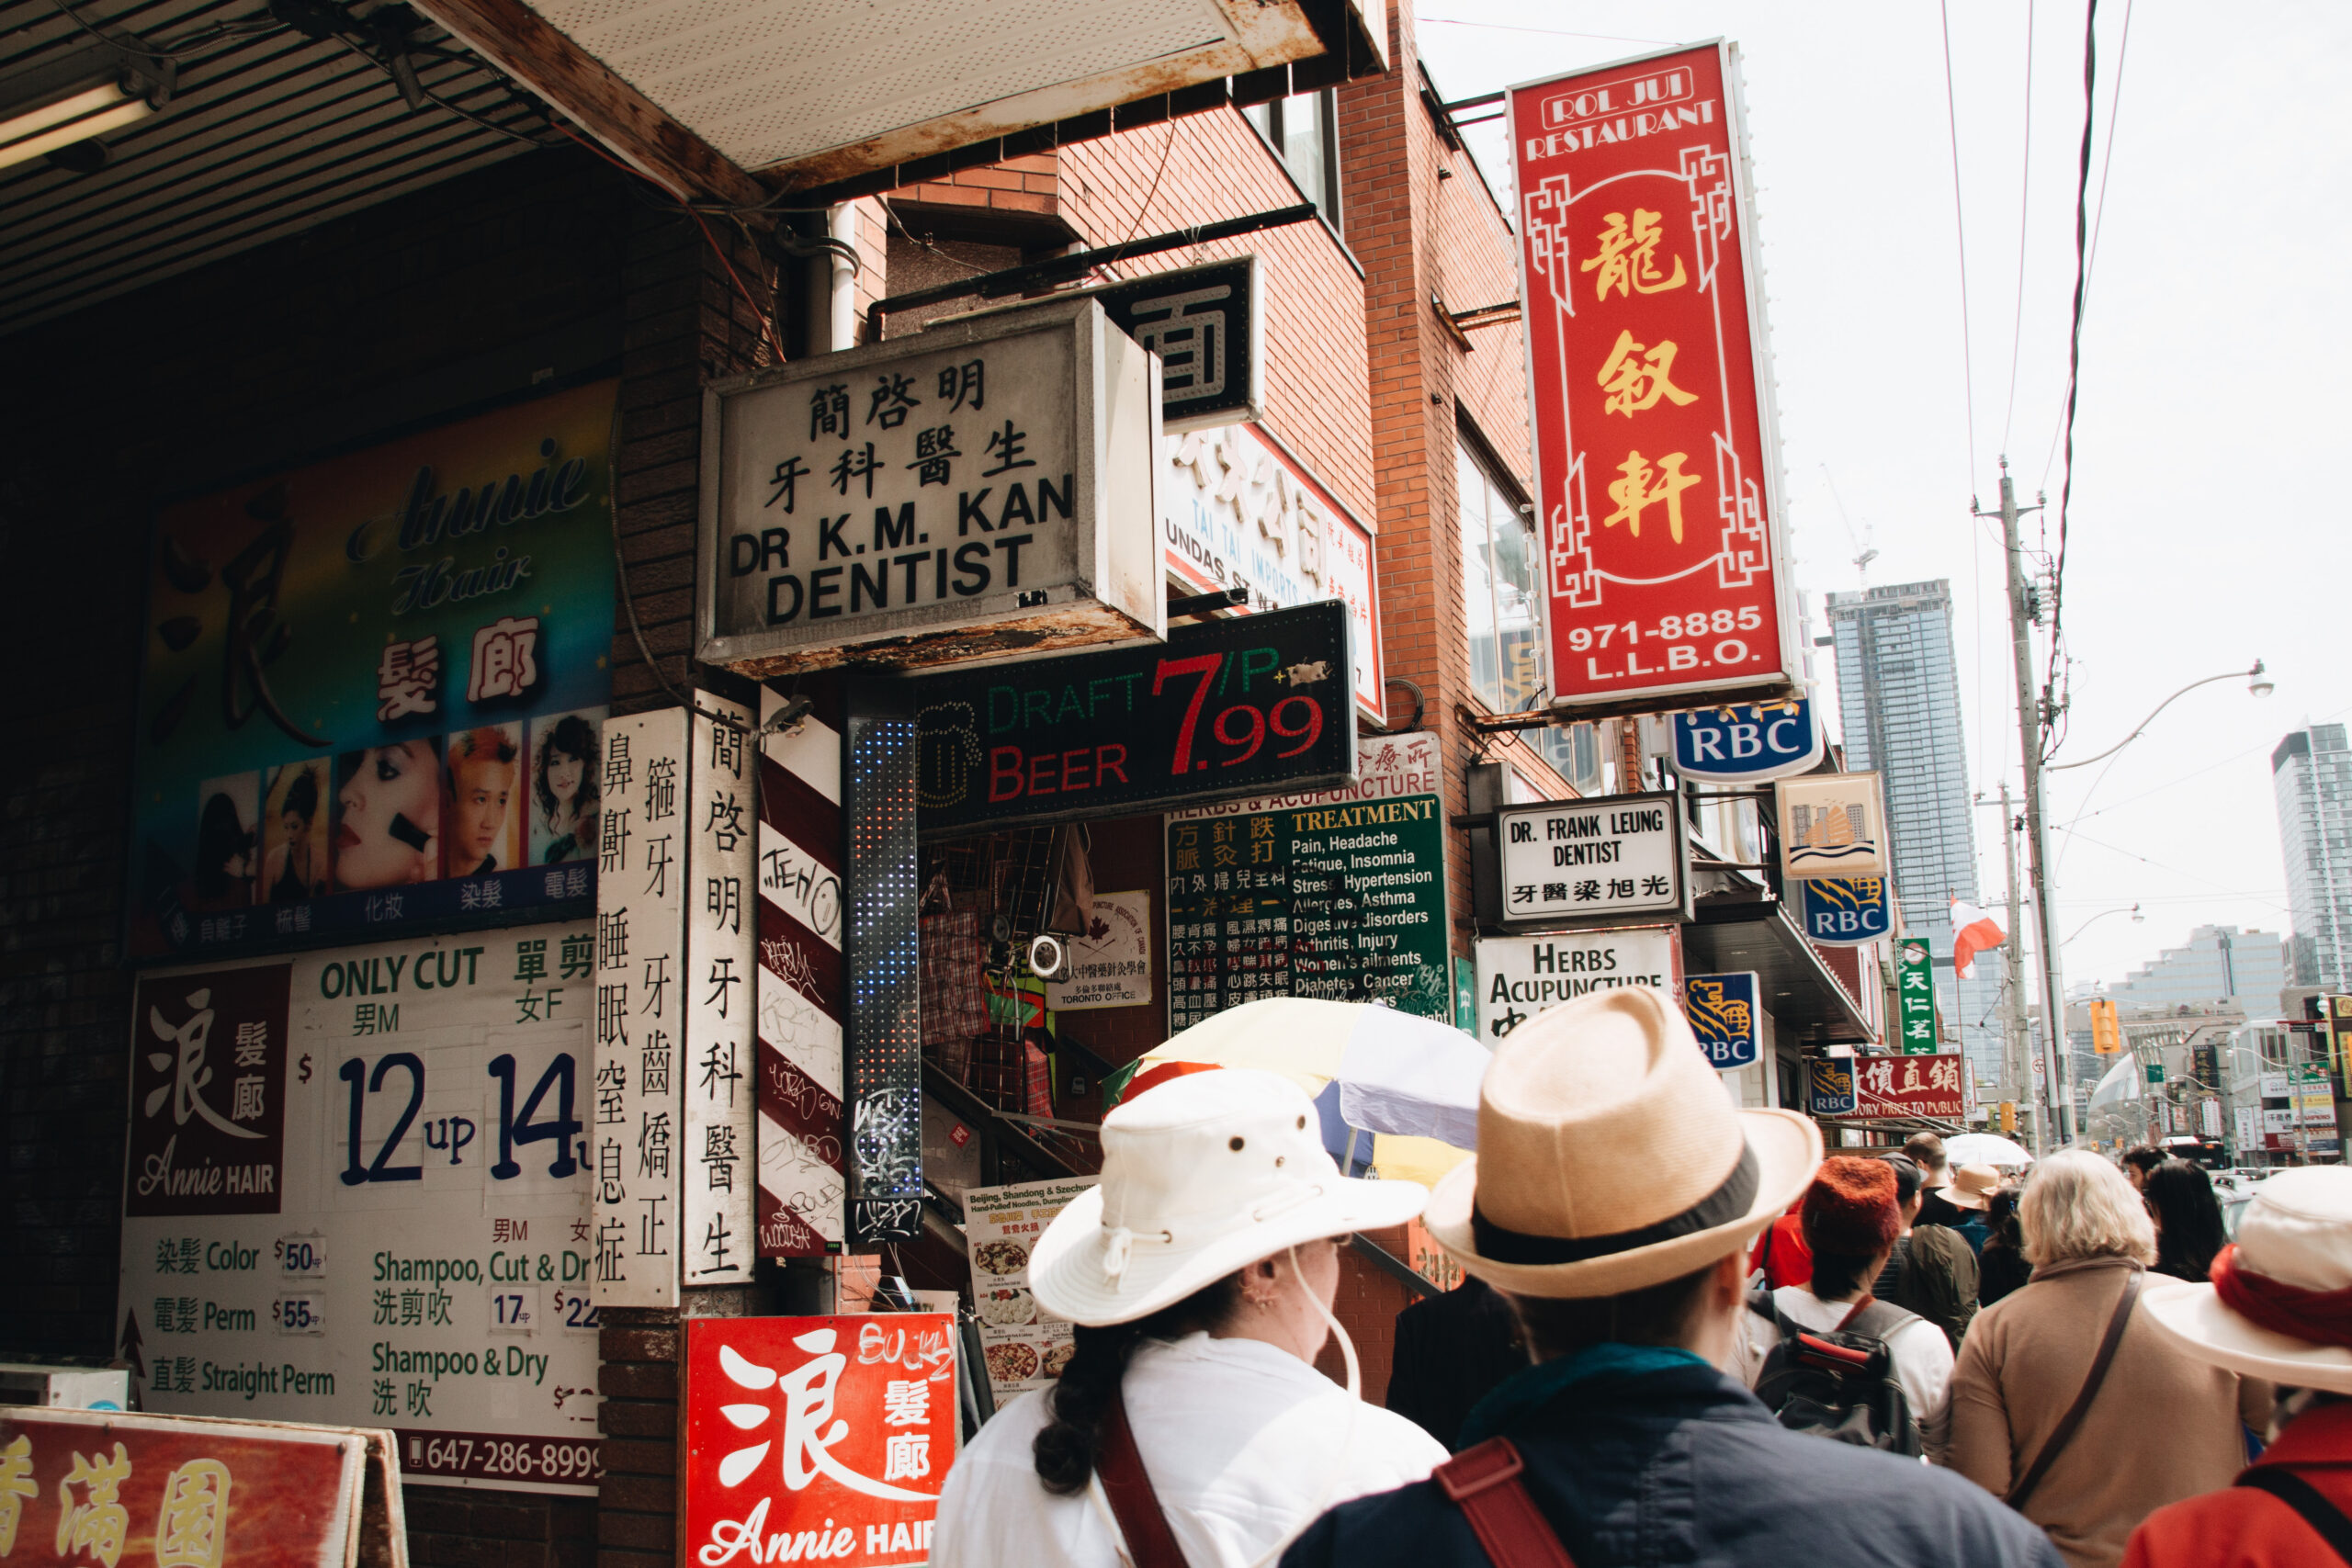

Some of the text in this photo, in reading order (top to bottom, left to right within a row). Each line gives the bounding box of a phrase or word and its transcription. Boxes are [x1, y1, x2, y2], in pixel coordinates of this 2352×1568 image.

[1626, 73, 1682, 107] JUI
[1526, 99, 1715, 162] RESTAURANT
[764, 419, 1037, 514] 牙科醫生
[346, 437, 587, 564] Annie
[731, 473, 1073, 578] DR K.M. KAN
[1193, 498, 1214, 543] TAI
[1222, 524, 1241, 565] TAI
[1251, 548, 1298, 606] IMPORTS
[391, 547, 530, 615] Hair
[767, 534, 1033, 626] DENTIST
[1568, 605, 1762, 652] 971-8885
[376, 615, 539, 723] 髮廊
[1587, 639, 1761, 681] L.L.B.O.
[989, 672, 1144, 734] DRAFT
[1150, 651, 1324, 776] 7.99
[1690, 717, 1800, 763] RBC
[988, 742, 1129, 805] BEER
[1292, 797, 1436, 833] TREATMENT
[1510, 809, 1663, 843] DR. FRANK LEUNG
[1292, 830, 1398, 855] Pain, Headache
[1351, 849, 1416, 869] Insomnia
[1554, 840, 1622, 867] DENTIST
[461, 879, 502, 910] 染髮
[545, 870, 588, 898] 電髮
[1344, 869, 1432, 892] Hypertension
[1362, 891, 1416, 908] Asthma
[1512, 875, 1669, 904] 牙醫梁旭光
[1362, 909, 1429, 928] disorders
[1816, 908, 1881, 935] RBC
[514, 934, 594, 985] 單剪
[1358, 933, 1398, 951] Injury
[1532, 942, 1617, 975] HERBS
[321, 947, 484, 998] ONLY CUT
[1295, 952, 1358, 974] Women's
[1363, 951, 1421, 968] ailments
[1363, 972, 1415, 988] Cancer
[1061, 992, 1136, 1004] TORONTO OFFICE
[145, 987, 269, 1139] 浪
[232, 1021, 266, 1122] 髮廊
[1855, 1057, 1961, 1096] 價直銷
[1816, 1096, 1850, 1110] RBC
[1845, 1100, 1962, 1117] TORY PRICE TO PUBLIC
[138, 1134, 274, 1196] Annie HAIR
[970, 1194, 1001, 1204] Beijing,
[1003, 1189, 1045, 1200] Shandong
[971, 1202, 1011, 1213] Hand-Pulled
[1012, 1200, 1041, 1208] Noodles,
[156, 1238, 201, 1274] 染髮
[207, 1241, 259, 1272] Color
[374, 1251, 484, 1287] Shampoo,
[491, 1250, 528, 1280] Cut
[537, 1255, 555, 1280] &
[154, 1297, 197, 1334] 電髮
[205, 1302, 255, 1332] Perm
[373, 1288, 453, 1327] 洗剪吹
[151, 1356, 334, 1400] 直髮 Straight Perm
[373, 1342, 548, 1385] Shampoo & Dry
[718, 1328, 941, 1502] 浪
[884, 1380, 930, 1481] 髮廊
[698, 1496, 857, 1565] Annie
